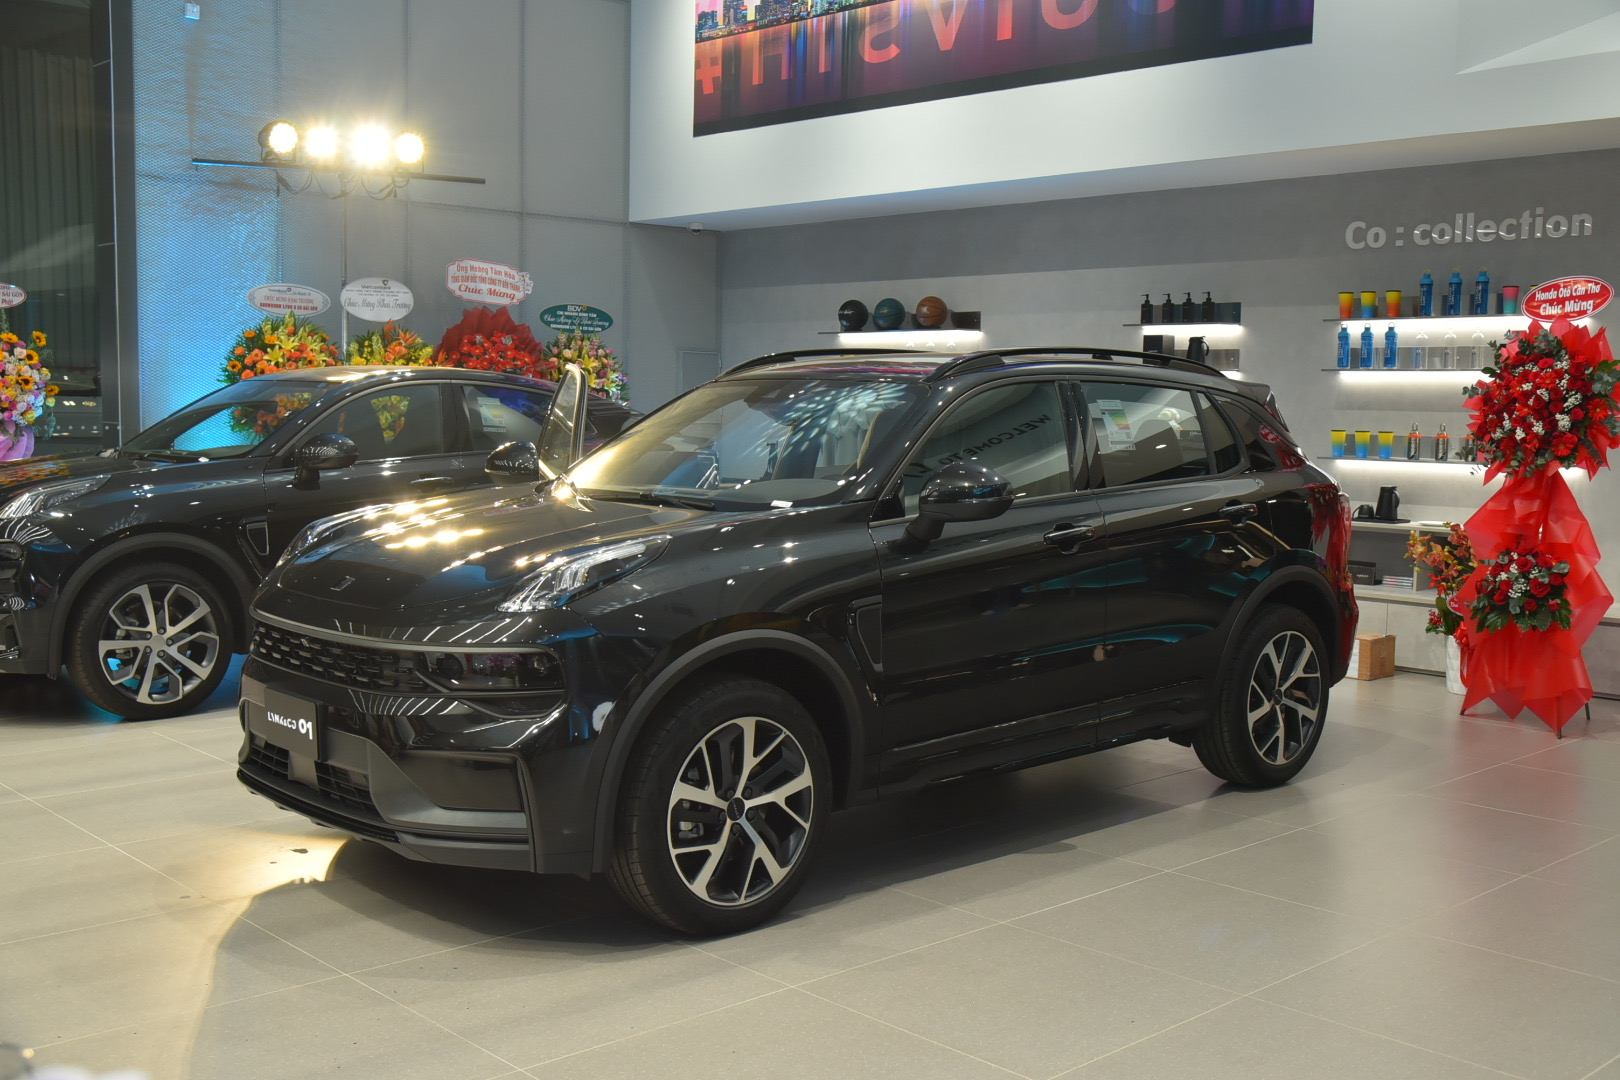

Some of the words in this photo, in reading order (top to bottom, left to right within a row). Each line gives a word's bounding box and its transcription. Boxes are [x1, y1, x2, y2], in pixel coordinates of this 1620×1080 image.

[1344, 220, 1387, 250] Co
[1412, 206, 1593, 246] collection
[458, 283, 484, 295] Chúc
[487, 287, 516, 301] Mừng
[1535, 288, 1557, 301] Honda
[1587, 282, 1602, 294] Thơ
[1539, 302, 1563, 316] Chúc
[1564, 299, 1594, 314] Mừng
[298, 718, 313, 741] 01
